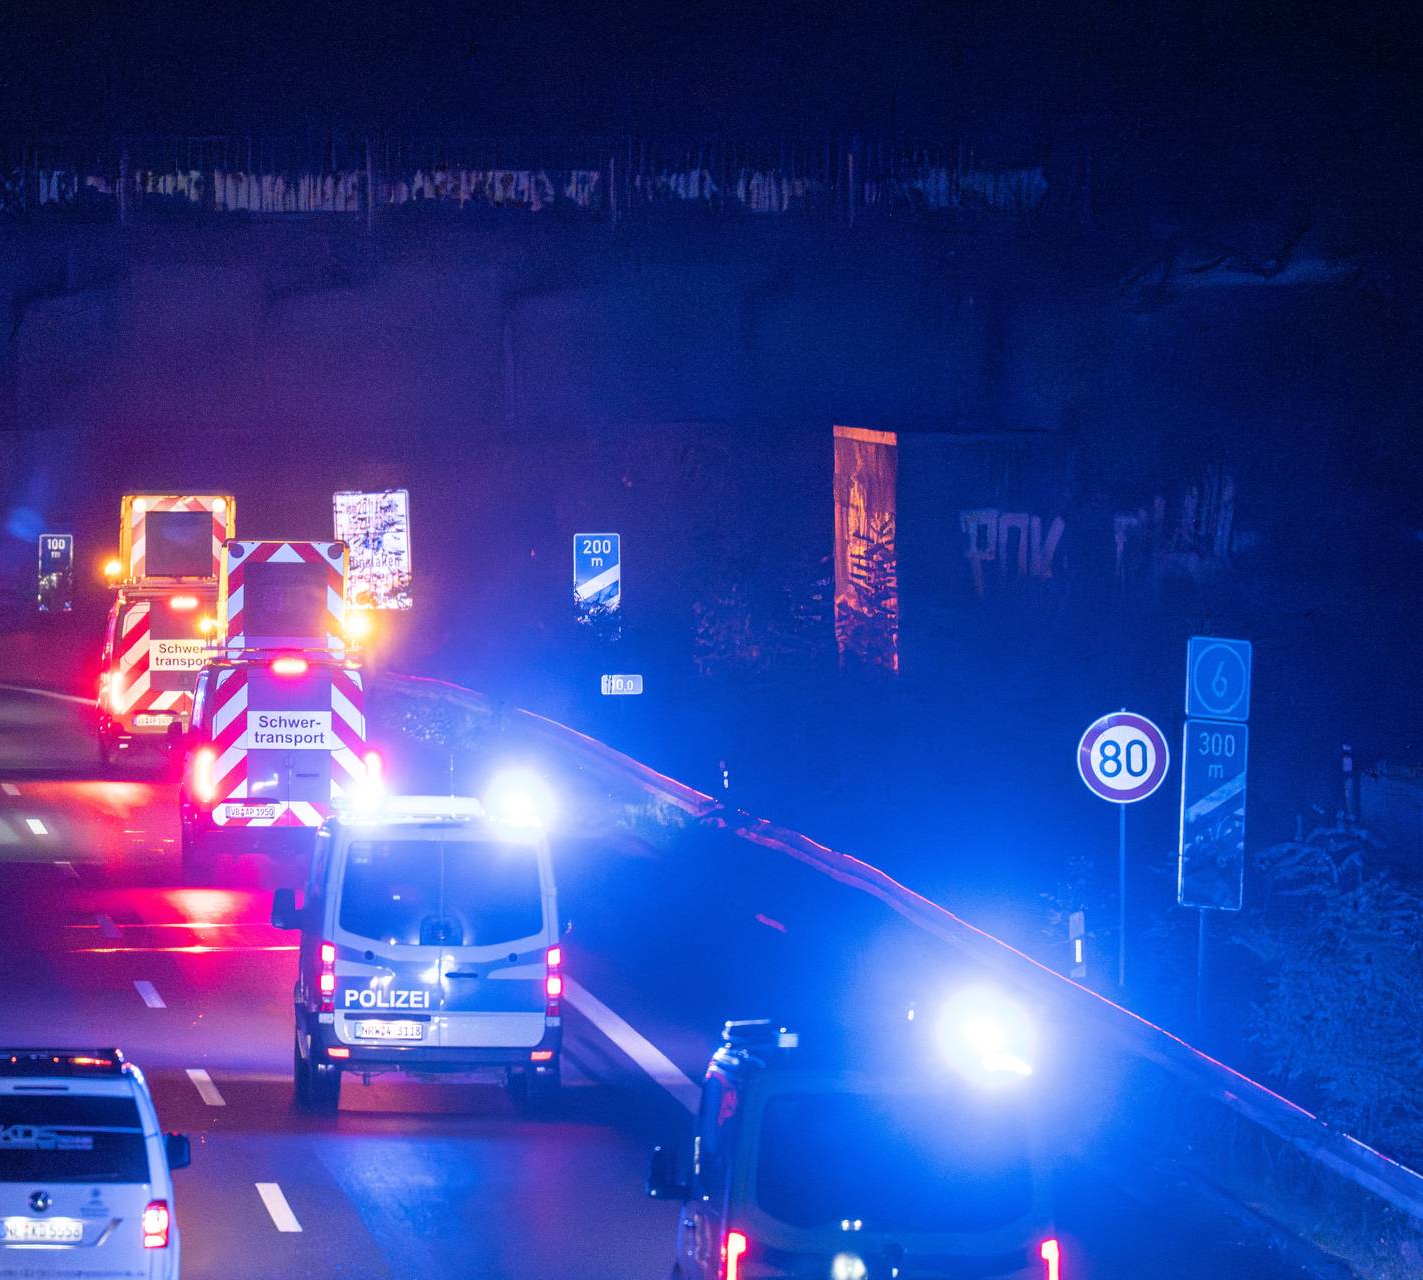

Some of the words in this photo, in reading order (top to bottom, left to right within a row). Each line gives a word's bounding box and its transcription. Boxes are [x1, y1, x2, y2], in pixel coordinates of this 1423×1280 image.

[47, 539, 66, 550] 100
[583, 540, 611, 554] 200
[51, 551, 61, 559] m
[591, 557, 603, 567] m
[159, 643, 204, 654] Schwer
[1212, 661, 1227, 698] 6
[259, 715, 321, 728] Schwer-
[254, 731, 325, 746] transport
[1198, 732, 1235, 757] 300
[1099, 739, 1148, 777] 80
[1209, 764, 1224, 778] m
[344, 989, 429, 1008] POLIZEI
